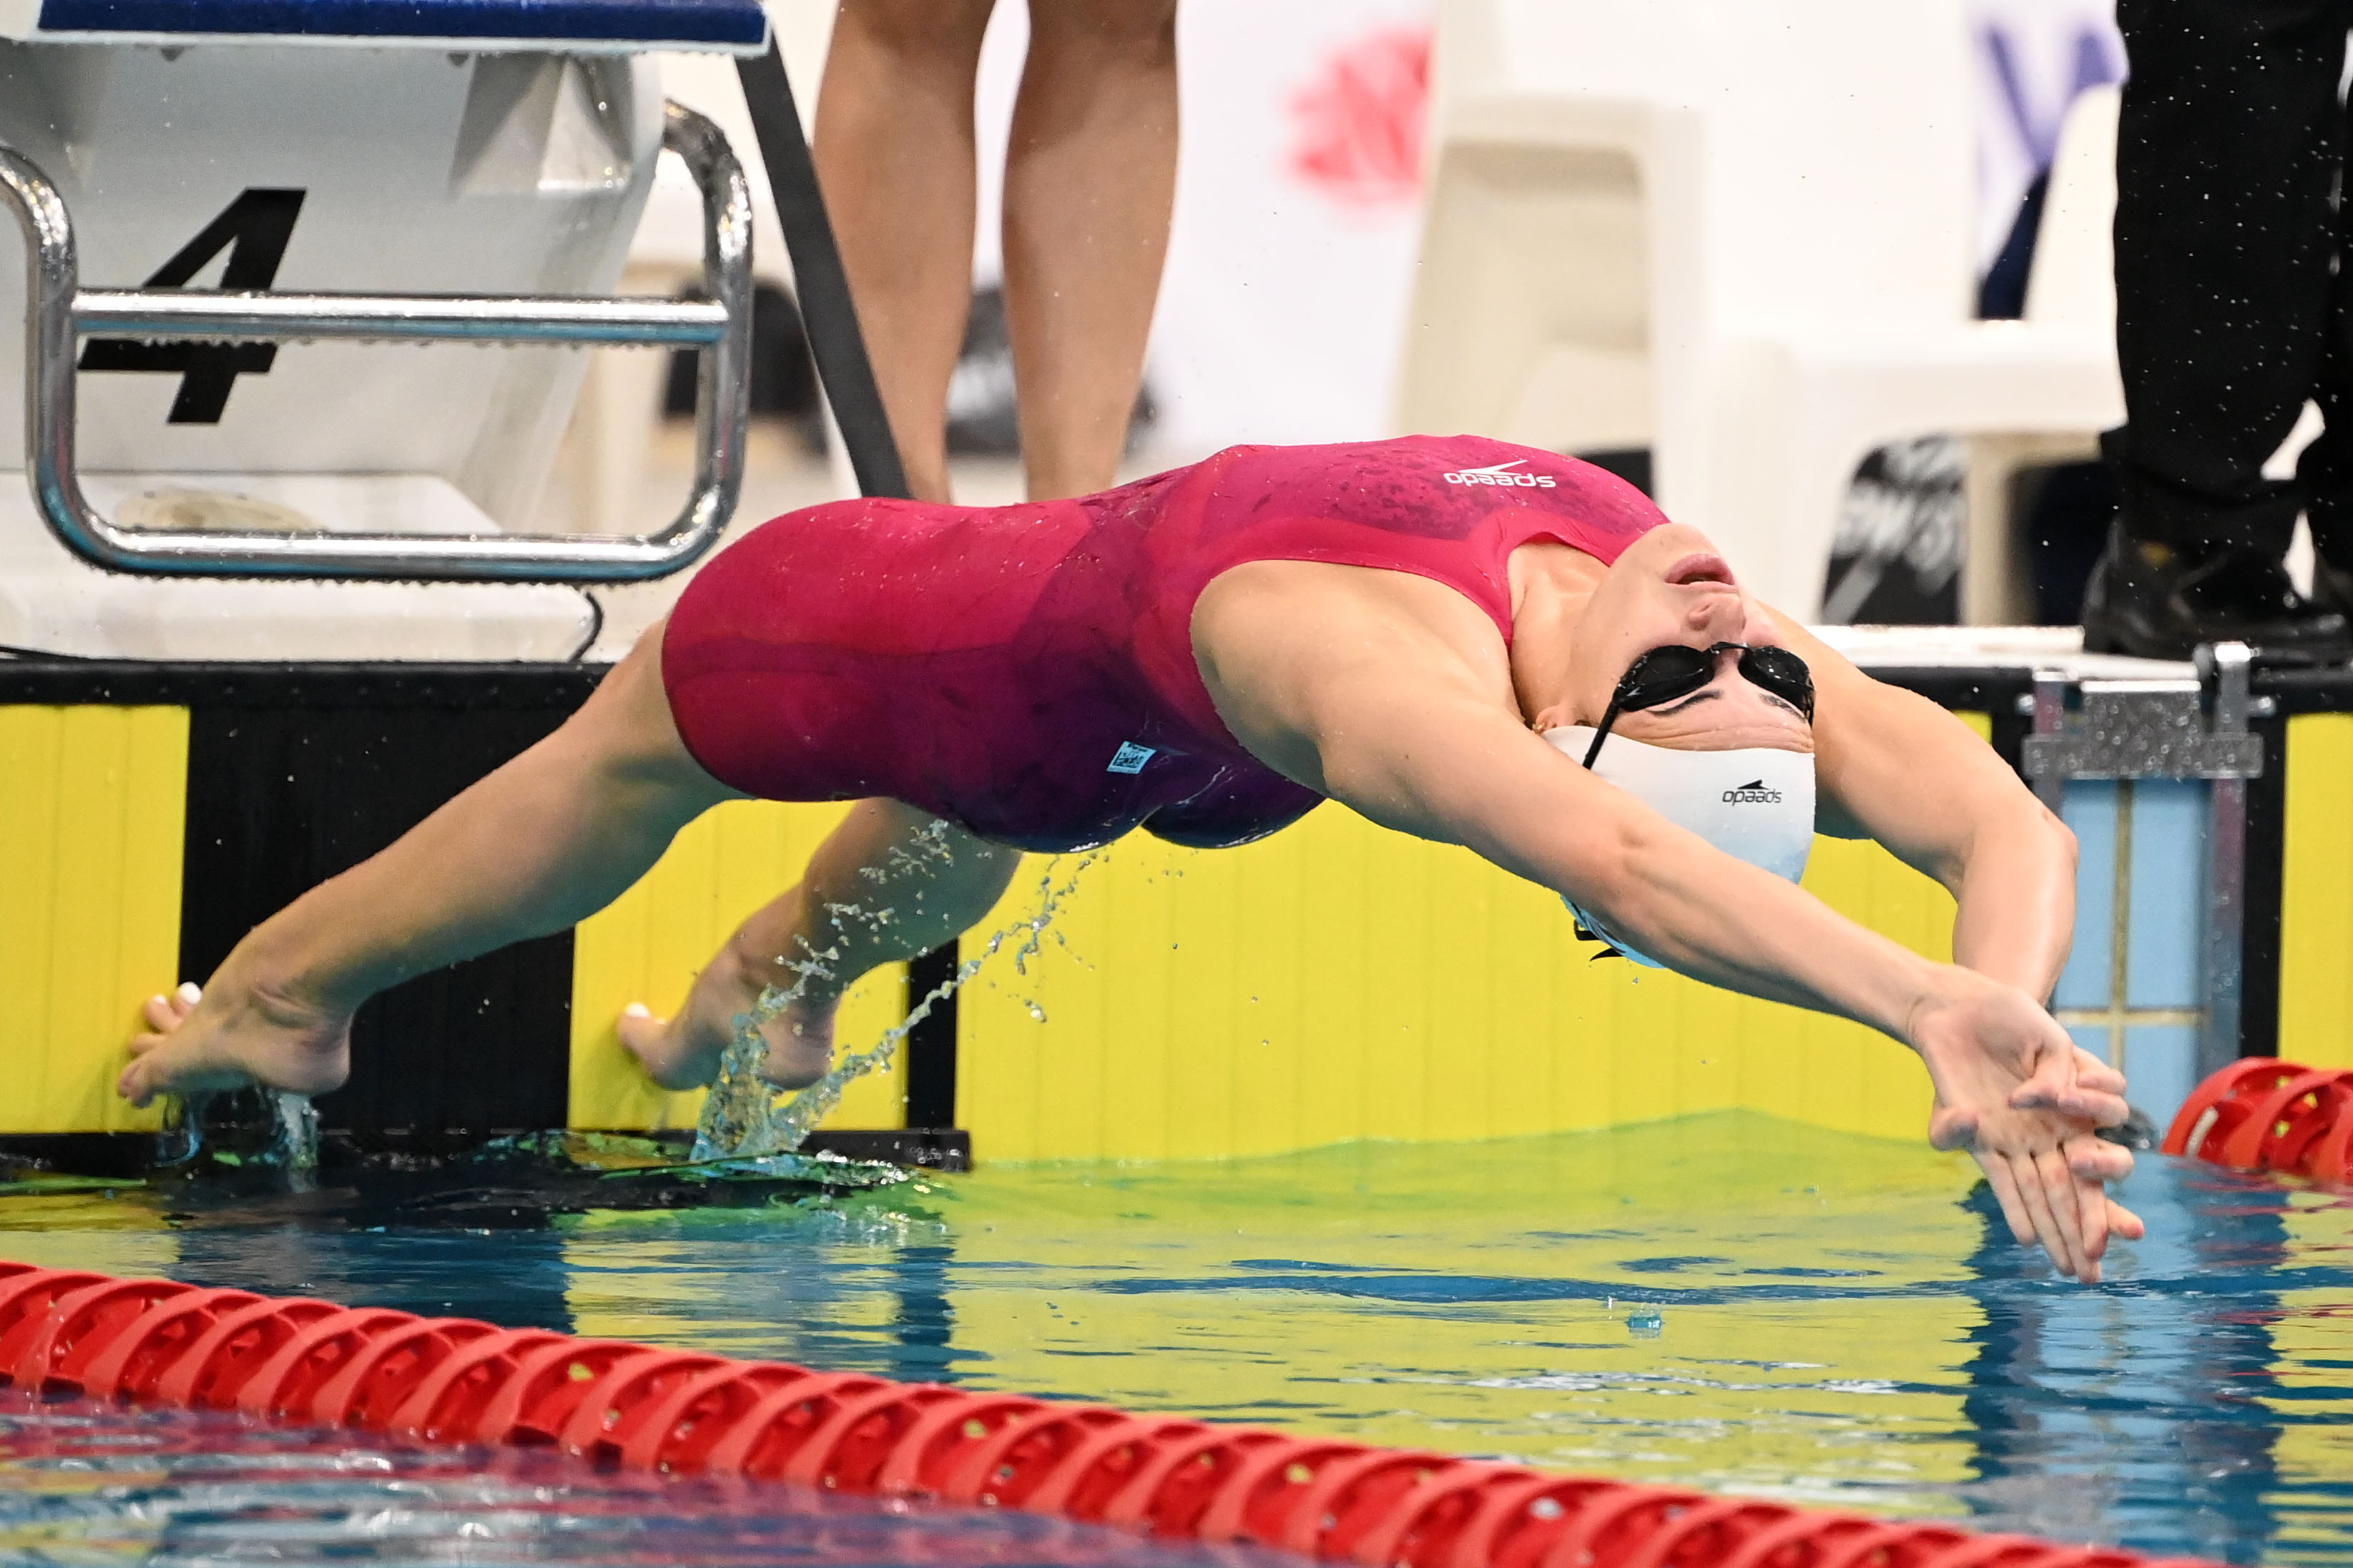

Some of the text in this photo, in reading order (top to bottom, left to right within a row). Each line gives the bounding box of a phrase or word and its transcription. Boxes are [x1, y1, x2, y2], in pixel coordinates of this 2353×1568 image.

[77, 188, 306, 423] 4
[1443, 472, 1556, 488] speedo
[1722, 788, 1782, 807] speedo
